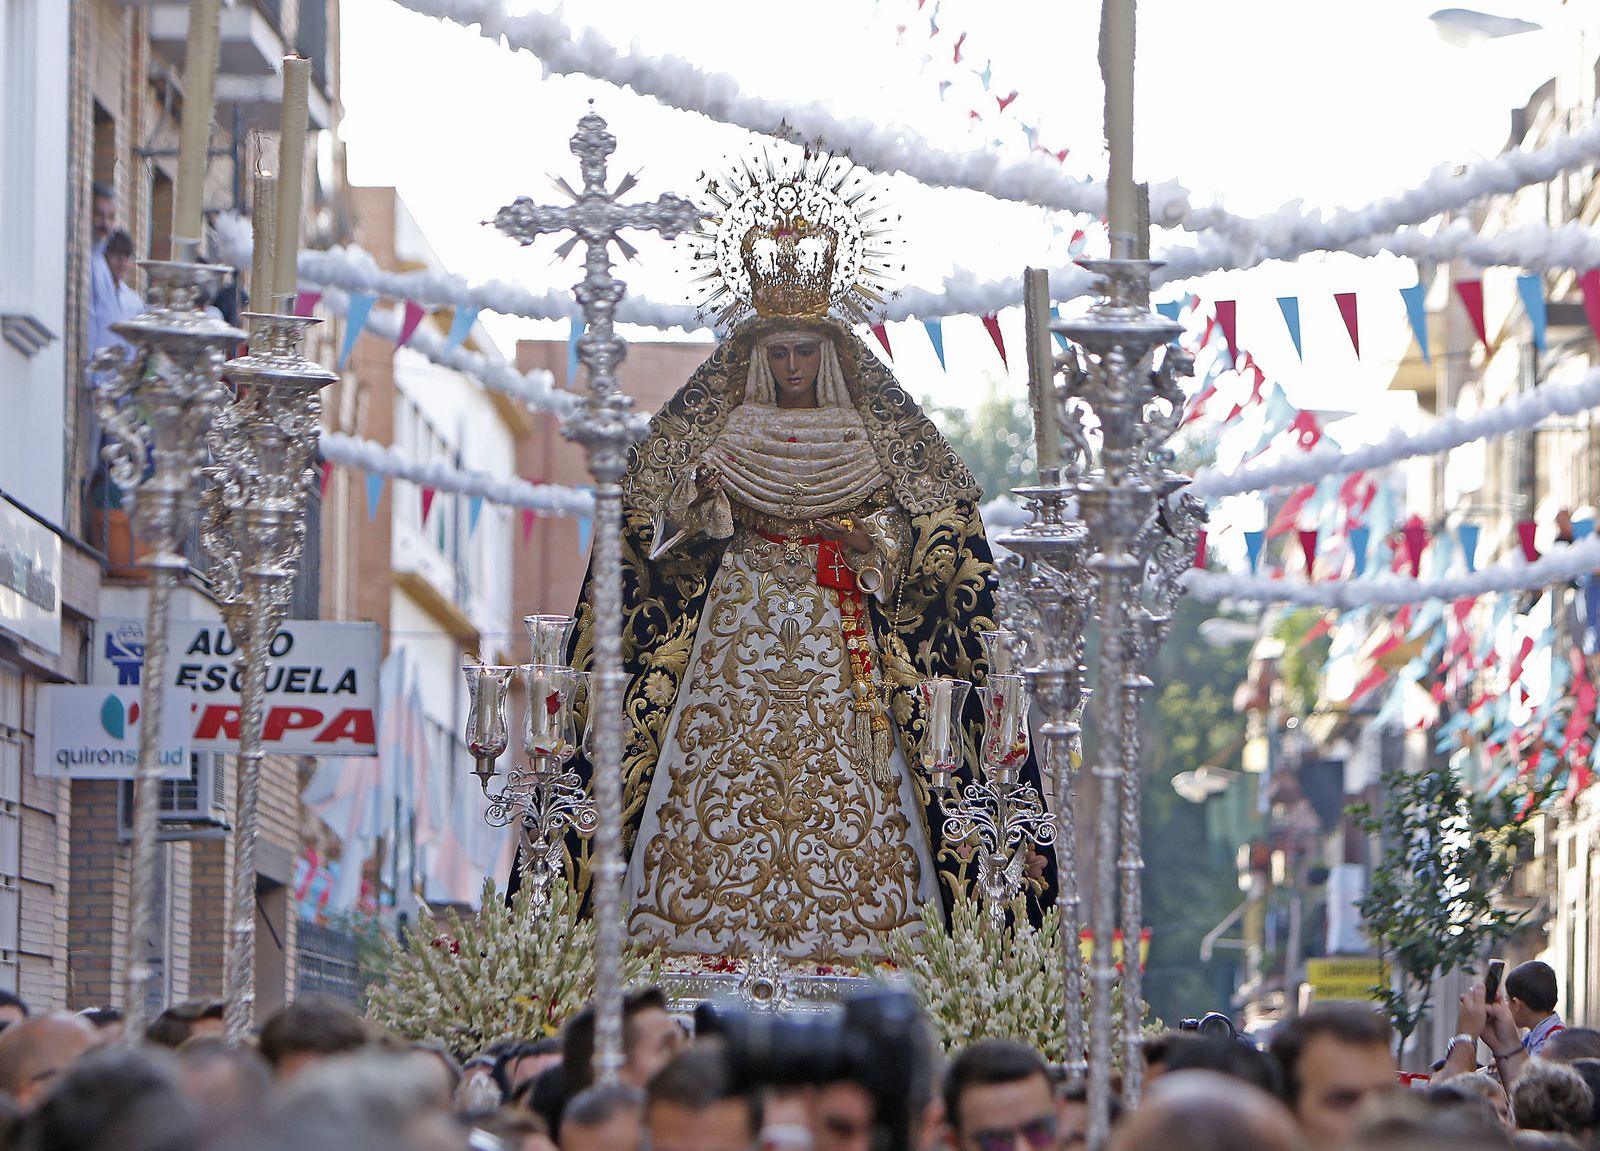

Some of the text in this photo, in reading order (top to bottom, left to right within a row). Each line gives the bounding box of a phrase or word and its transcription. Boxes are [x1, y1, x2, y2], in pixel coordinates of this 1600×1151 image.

[184, 627, 294, 657] AUO
[190, 703, 376, 744] RPA
[56, 744, 183, 770] quironsud
